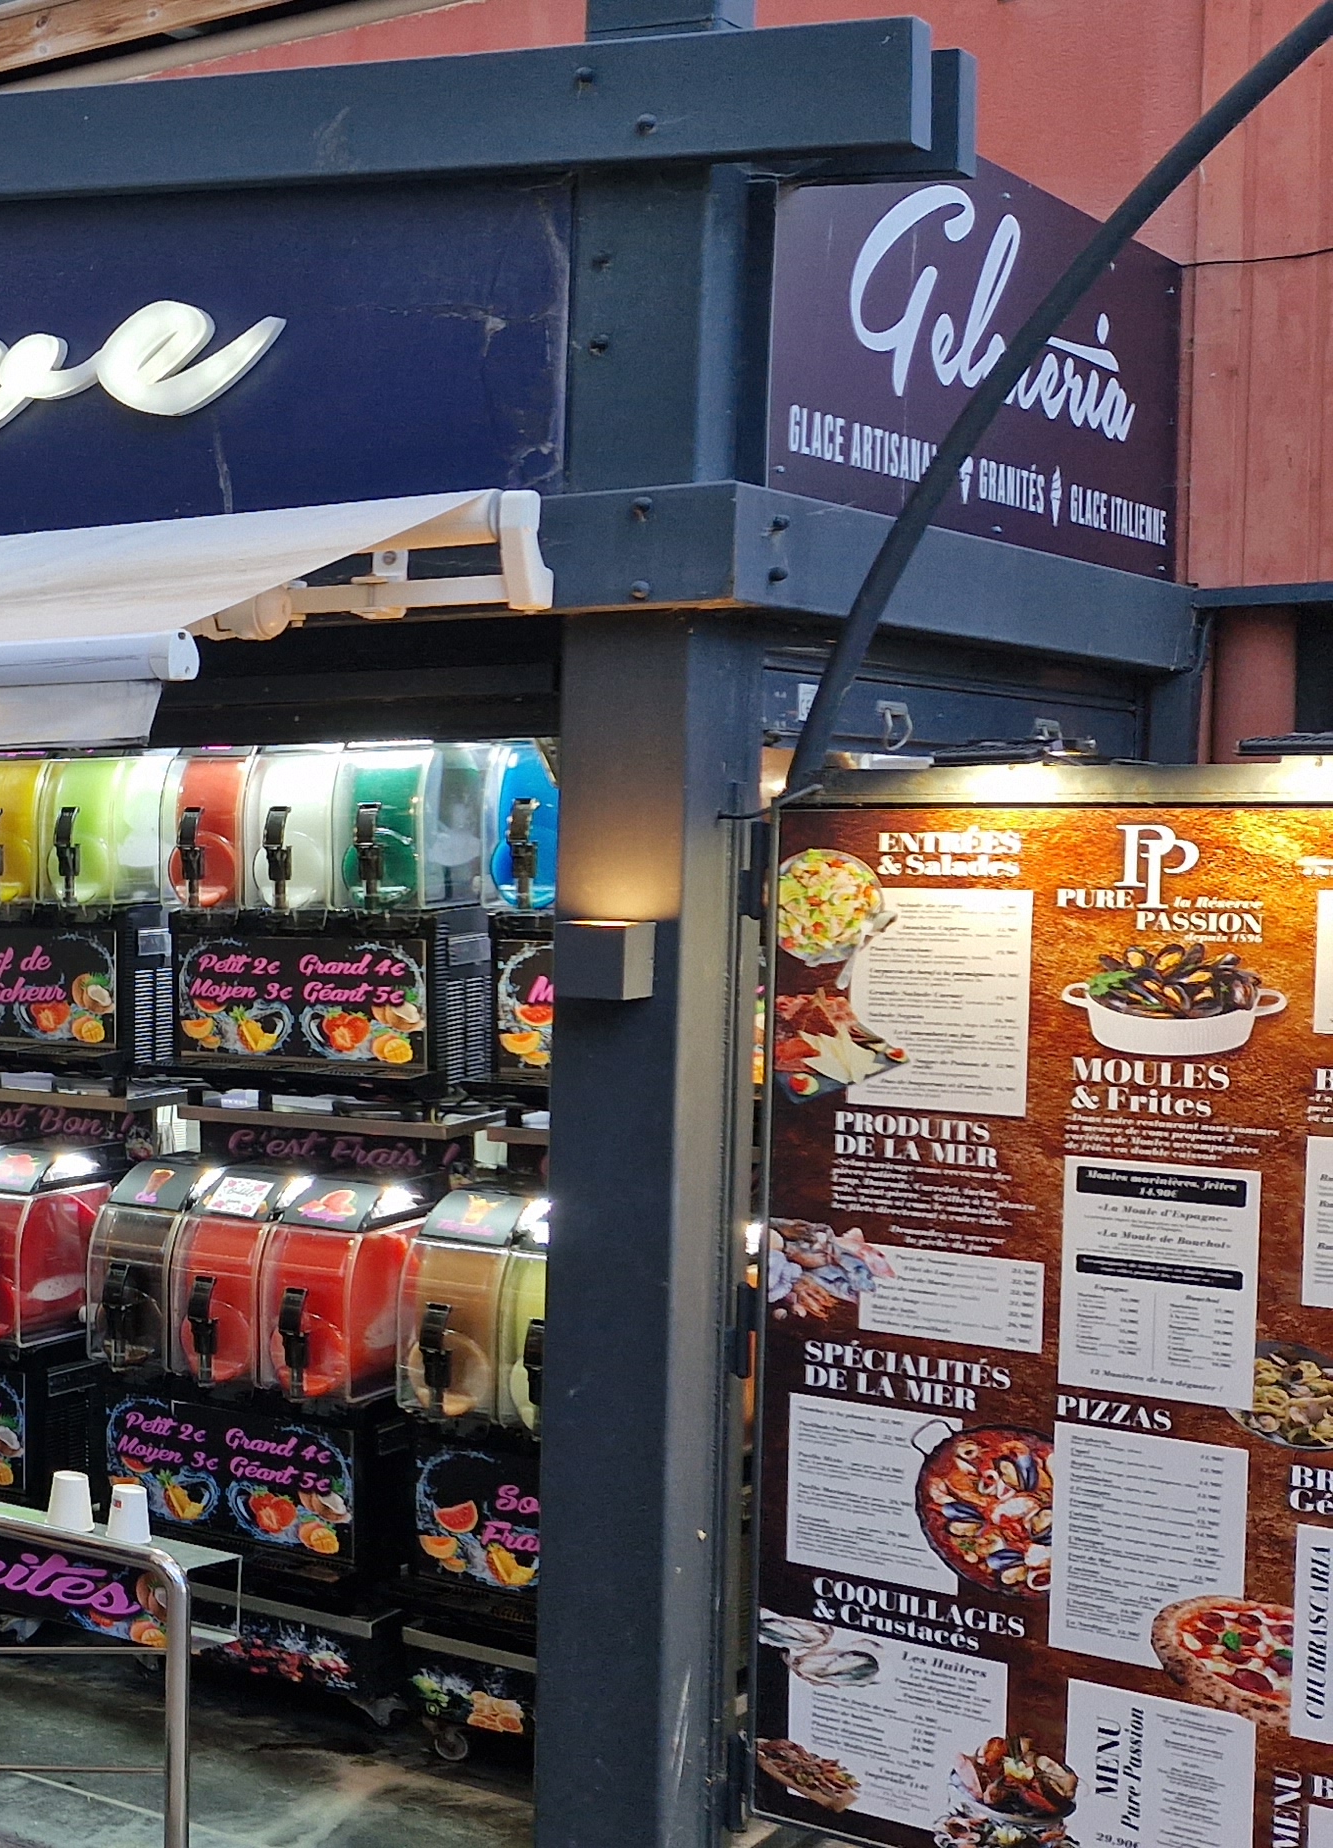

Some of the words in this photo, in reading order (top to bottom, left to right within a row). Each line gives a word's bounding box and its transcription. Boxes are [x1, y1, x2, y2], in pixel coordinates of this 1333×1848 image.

[788, 404, 845, 464] GLACE
[850, 422, 938, 484] ARTISANA
[979, 458, 1044, 514] GRANITÉS
[1070, 484, 1107, 530] GLACE
[1110, 501, 1167, 546] ITALIENNE
[878, 826, 1021, 853] ENTRÉES
[877, 855, 902, 875] &
[905, 854, 1020, 876] Salades
[1056, 888, 1134, 909] PURE
[1173, 896, 1191, 908] la
[1136, 910, 1262, 933] PASSION
[20, 945, 52, 972] de
[198, 954, 251, 975] Petit
[299, 953, 372, 976] Grand
[190, 978, 258, 1002] Moyen
[302, 981, 372, 1004] Géant
[1070, 1056, 1230, 1090] MOULES
[1070, 1084, 1099, 1110] &
[1107, 1086, 1212, 1118] Frites
[35, 1106, 103, 1136] Bon
[834, 1110, 991, 1143] PRODUITS
[228, 1129, 326, 1159] C'est
[331, 1136, 422, 1168] Frais
[834, 1133, 876, 1158] DE
[883, 1137, 921, 1162] LA
[930, 1141, 998, 1169] MER
[804, 1340, 1011, 1390] SPÉCIALITÉS
[804, 1364, 848, 1391] DE
[857, 1371, 895, 1399] LA
[905, 1379, 977, 1412] MER
[1056, 1394, 1172, 1432] PIZZAS
[125, 1411, 175, 1436] Petit
[224, 1427, 293, 1458] Grand
[117, 1434, 183, 1465] Moyen
[230, 1456, 299, 1487] Géant
[495, 1485, 540, 1514] So
[812, 1576, 1025, 1637] COQUILLAGES
[812, 1599, 836, 1620] &
[840, 1604, 980, 1651] Crustacés
[1306, 1546, 1332, 1720] CHURRASCARIA
[1095, 1716, 1122, 1799] MENU
[1123, 1707, 1144, 1782] Passion
[1121, 1785, 1142, 1832] Pure
